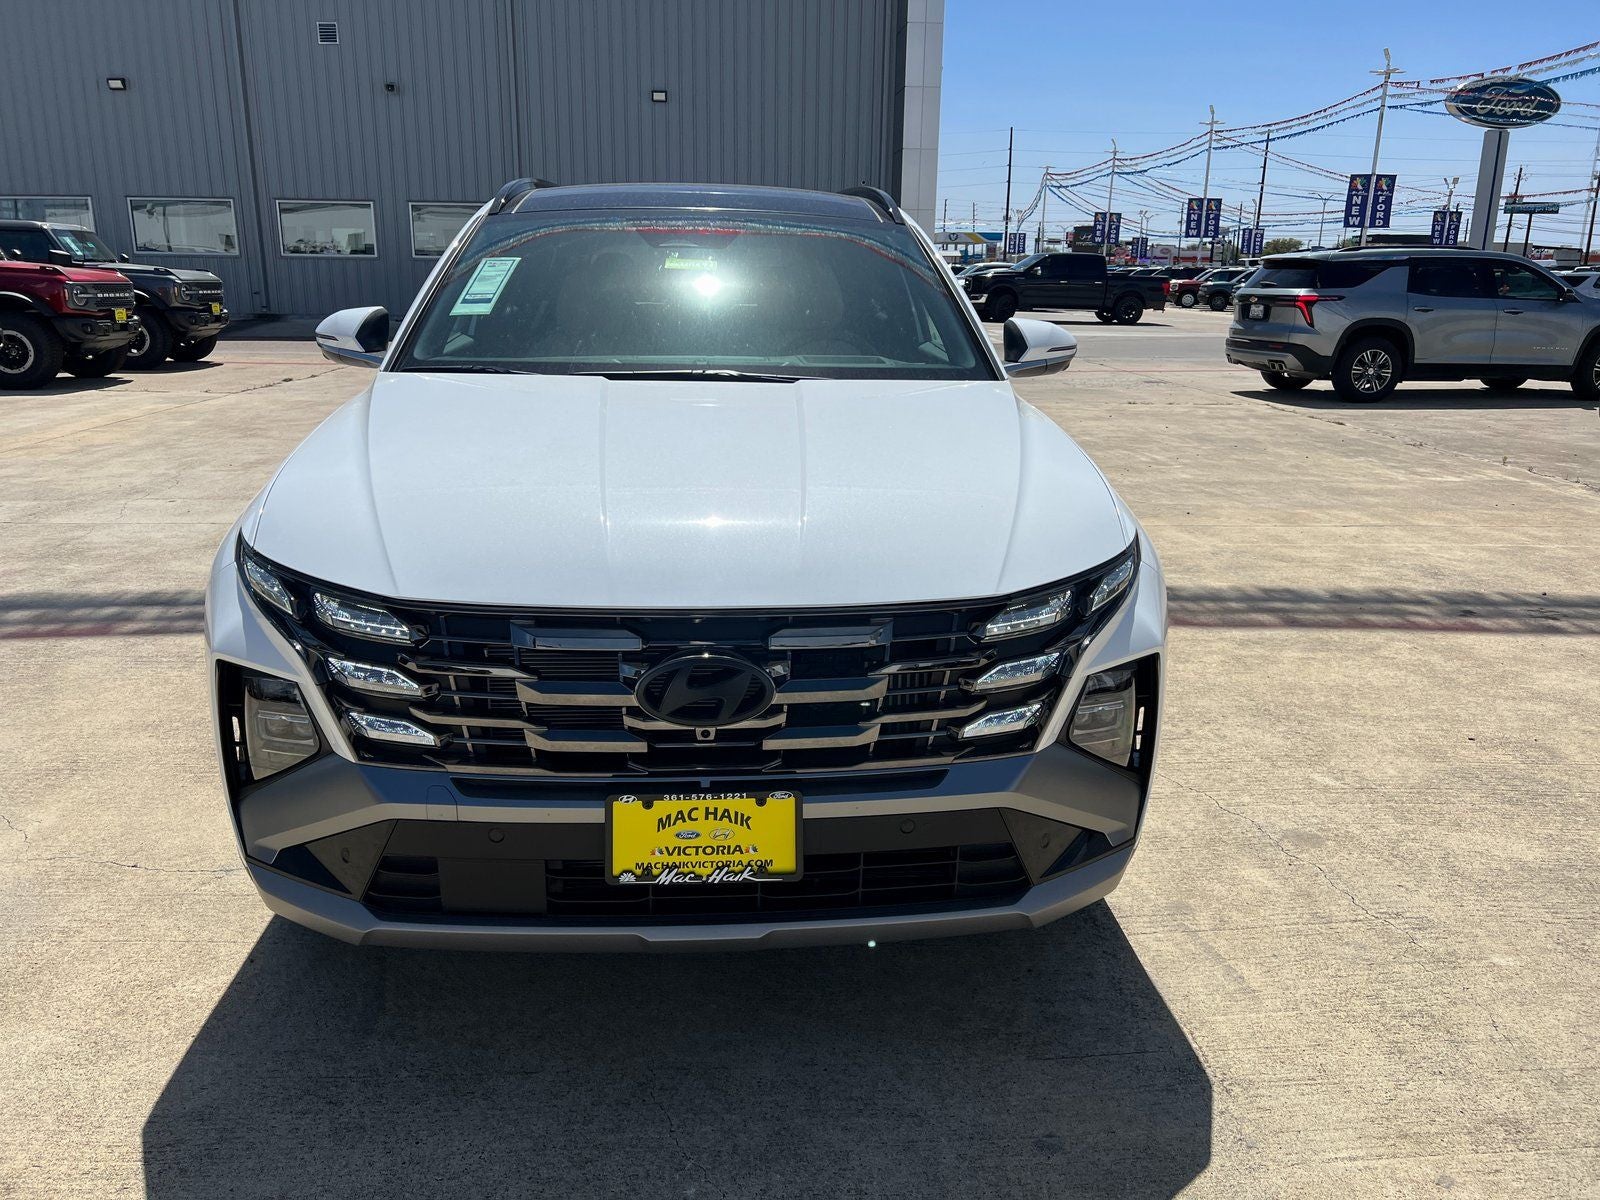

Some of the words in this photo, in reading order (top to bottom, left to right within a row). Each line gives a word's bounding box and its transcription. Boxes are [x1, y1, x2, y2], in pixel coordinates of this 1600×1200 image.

[1476, 86, 1538, 116] Ford
[1348, 195, 1362, 226] NEW
[1375, 195, 1386, 226] FORD
[1189, 214, 1198, 236] NEW
[1433, 225, 1441, 244] NEW
[1448, 225, 1456, 245] FORD
[663, 793, 747, 801] 361-576-1221
[657, 807, 699, 833] MAC
[704, 807, 752, 830] HAIK
[664, 845, 744, 857] VICTORIA
[635, 859, 774, 870] MACHAIKVICTORIA.COM
[655, 867, 697, 885] Mac
[707, 867, 756, 884] Haik
